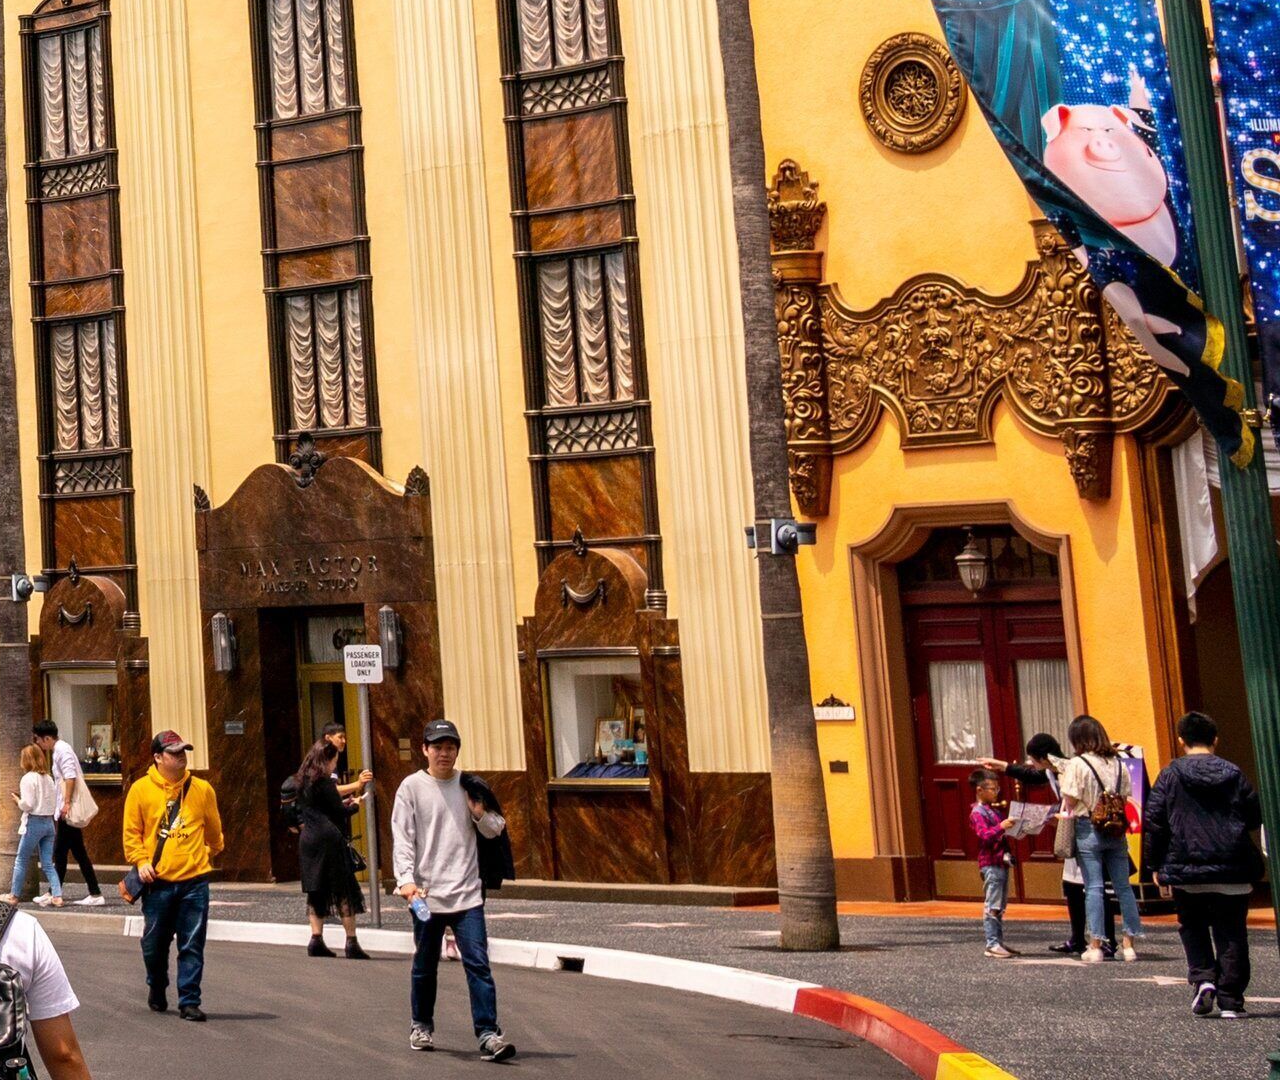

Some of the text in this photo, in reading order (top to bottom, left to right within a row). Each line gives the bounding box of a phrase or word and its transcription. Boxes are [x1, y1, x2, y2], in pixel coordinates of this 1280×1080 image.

[240, 555, 379, 578] MAX FACTOR
[317, 576, 359, 591] STUDIO
[346, 651, 380, 659] PASSENGER
[351, 660, 376, 668] LOADING
[356, 669, 371, 677] ONLY
